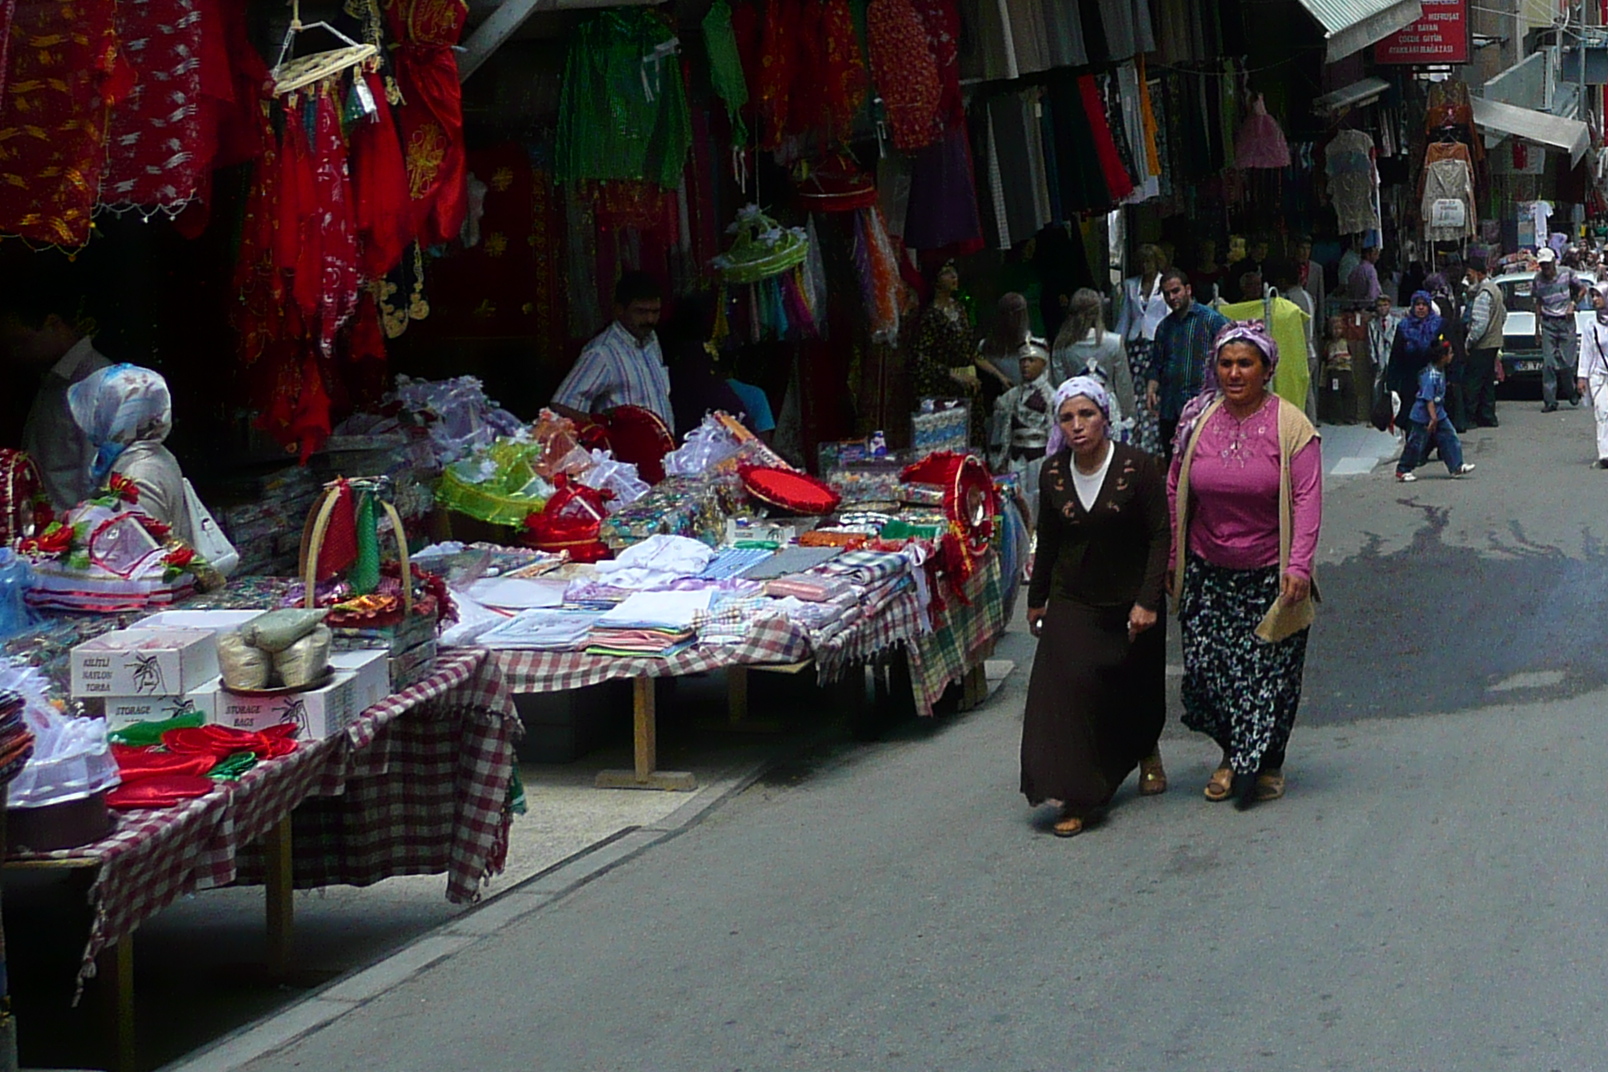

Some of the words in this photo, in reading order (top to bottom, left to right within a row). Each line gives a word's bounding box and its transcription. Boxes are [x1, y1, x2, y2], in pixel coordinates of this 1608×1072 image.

[115, 706, 151, 716] STORAGE
[225, 705, 261, 715] STORAGE
[233, 718, 254, 727] BAGS
